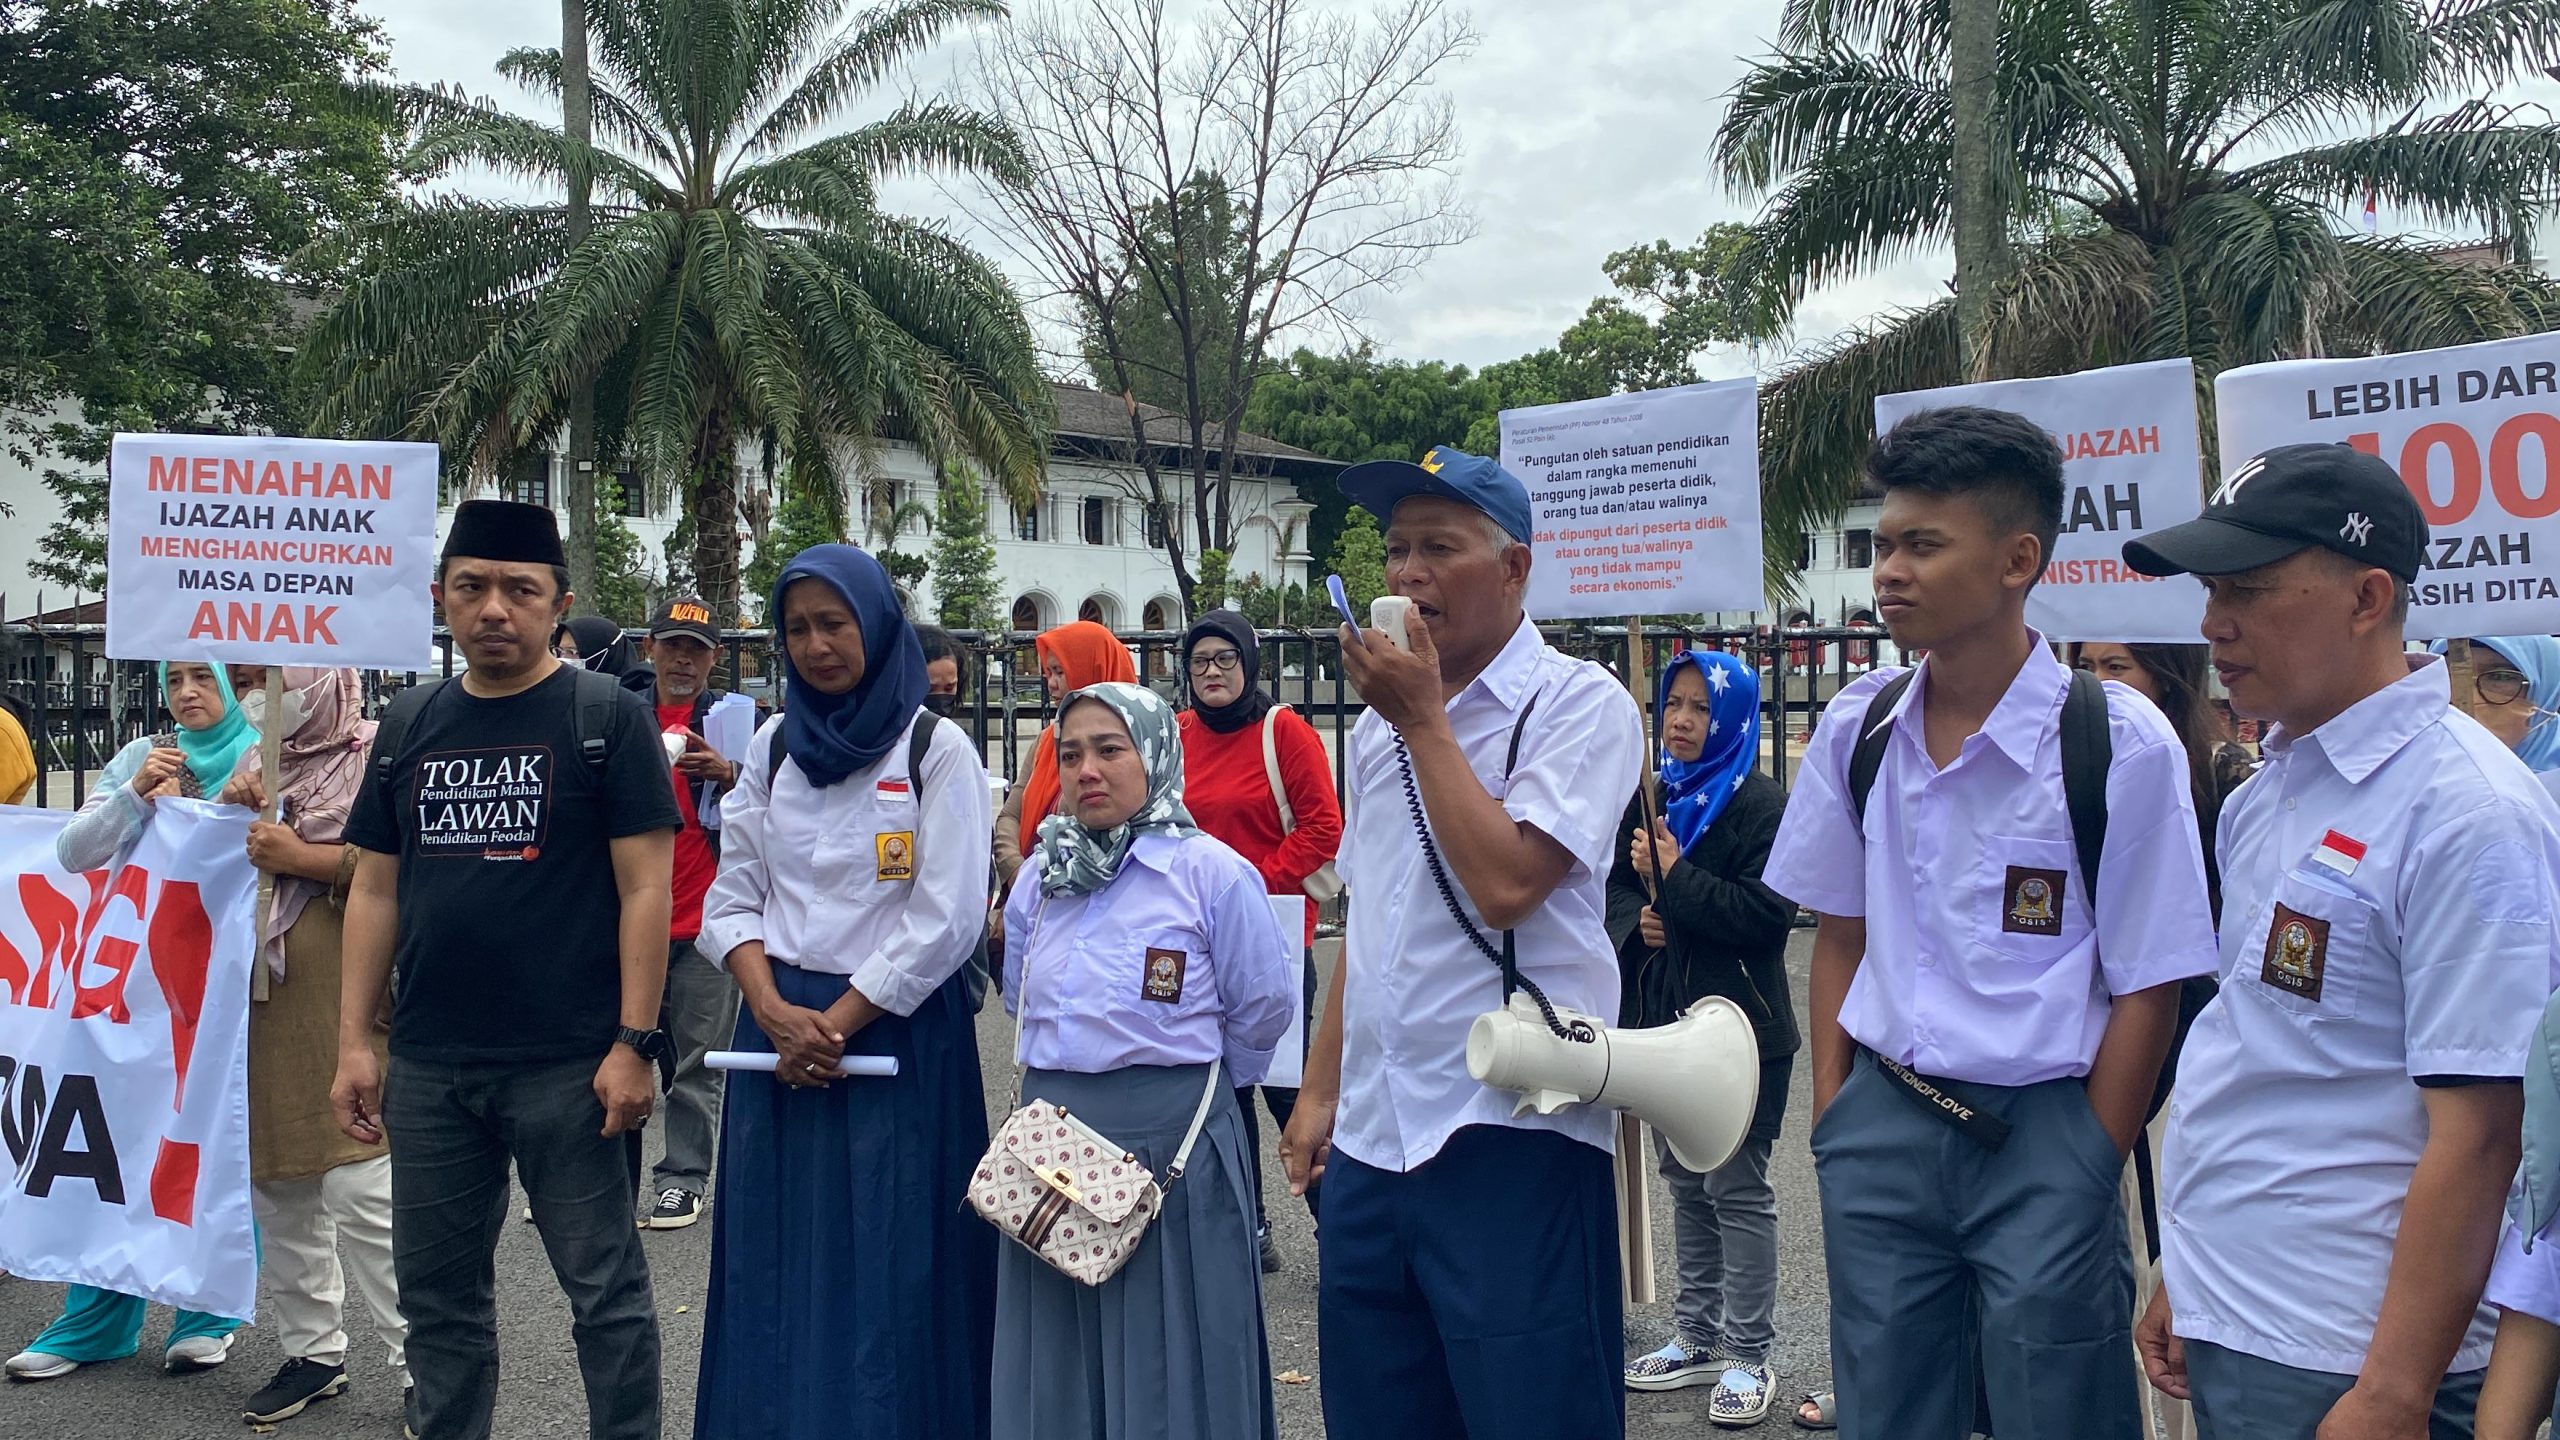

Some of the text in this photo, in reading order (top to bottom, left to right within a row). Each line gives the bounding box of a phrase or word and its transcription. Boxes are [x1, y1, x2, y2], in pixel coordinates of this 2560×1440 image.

[2307, 375, 2440, 421] LEBIH
[1583, 446, 1608, 461] oleh
[1612, 444, 1653, 458] satuan
[1657, 434, 1729, 456] pendidikan
[2052, 426, 2160, 461] JAZAH
[148, 455, 392, 500] MENAHAN
[1547, 456, 1697, 483] dalam rangka memenuhi
[2346, 412, 2560, 526] 00
[1531, 473, 1716, 503] tanggung jawab peserta didik,
[160, 502, 376, 534] IJAZAH ANAK
[1543, 493, 1708, 520] orang tua dan/atau walinya
[1559, 524, 1613, 543] dipungut
[1616, 521, 1639, 536] dari
[1643, 520, 1691, 540] peserta
[1695, 516, 1728, 531] didik
[2339, 512, 2375, 547] NY
[140, 536, 392, 566] MENGHANCURKAN
[1555, 538, 1693, 560] atau orang tua/walinya
[1570, 558, 1681, 579] yang tidak mampu
[178, 569, 353, 596] MASA DEPAN
[1570, 581, 1610, 594] secara
[2485, 577, 2559, 602] DITA
[187, 600, 340, 645] ANAK
[423, 755, 543, 788] TOLAK
[420, 782, 543, 801] Pendidikan Mahal
[418, 799, 542, 832] LAWAN
[421, 829, 536, 845] Pendidikan Feodal
[2019, 917, 2046, 926] OSIS
[2277, 970, 2303, 987] OSIS
